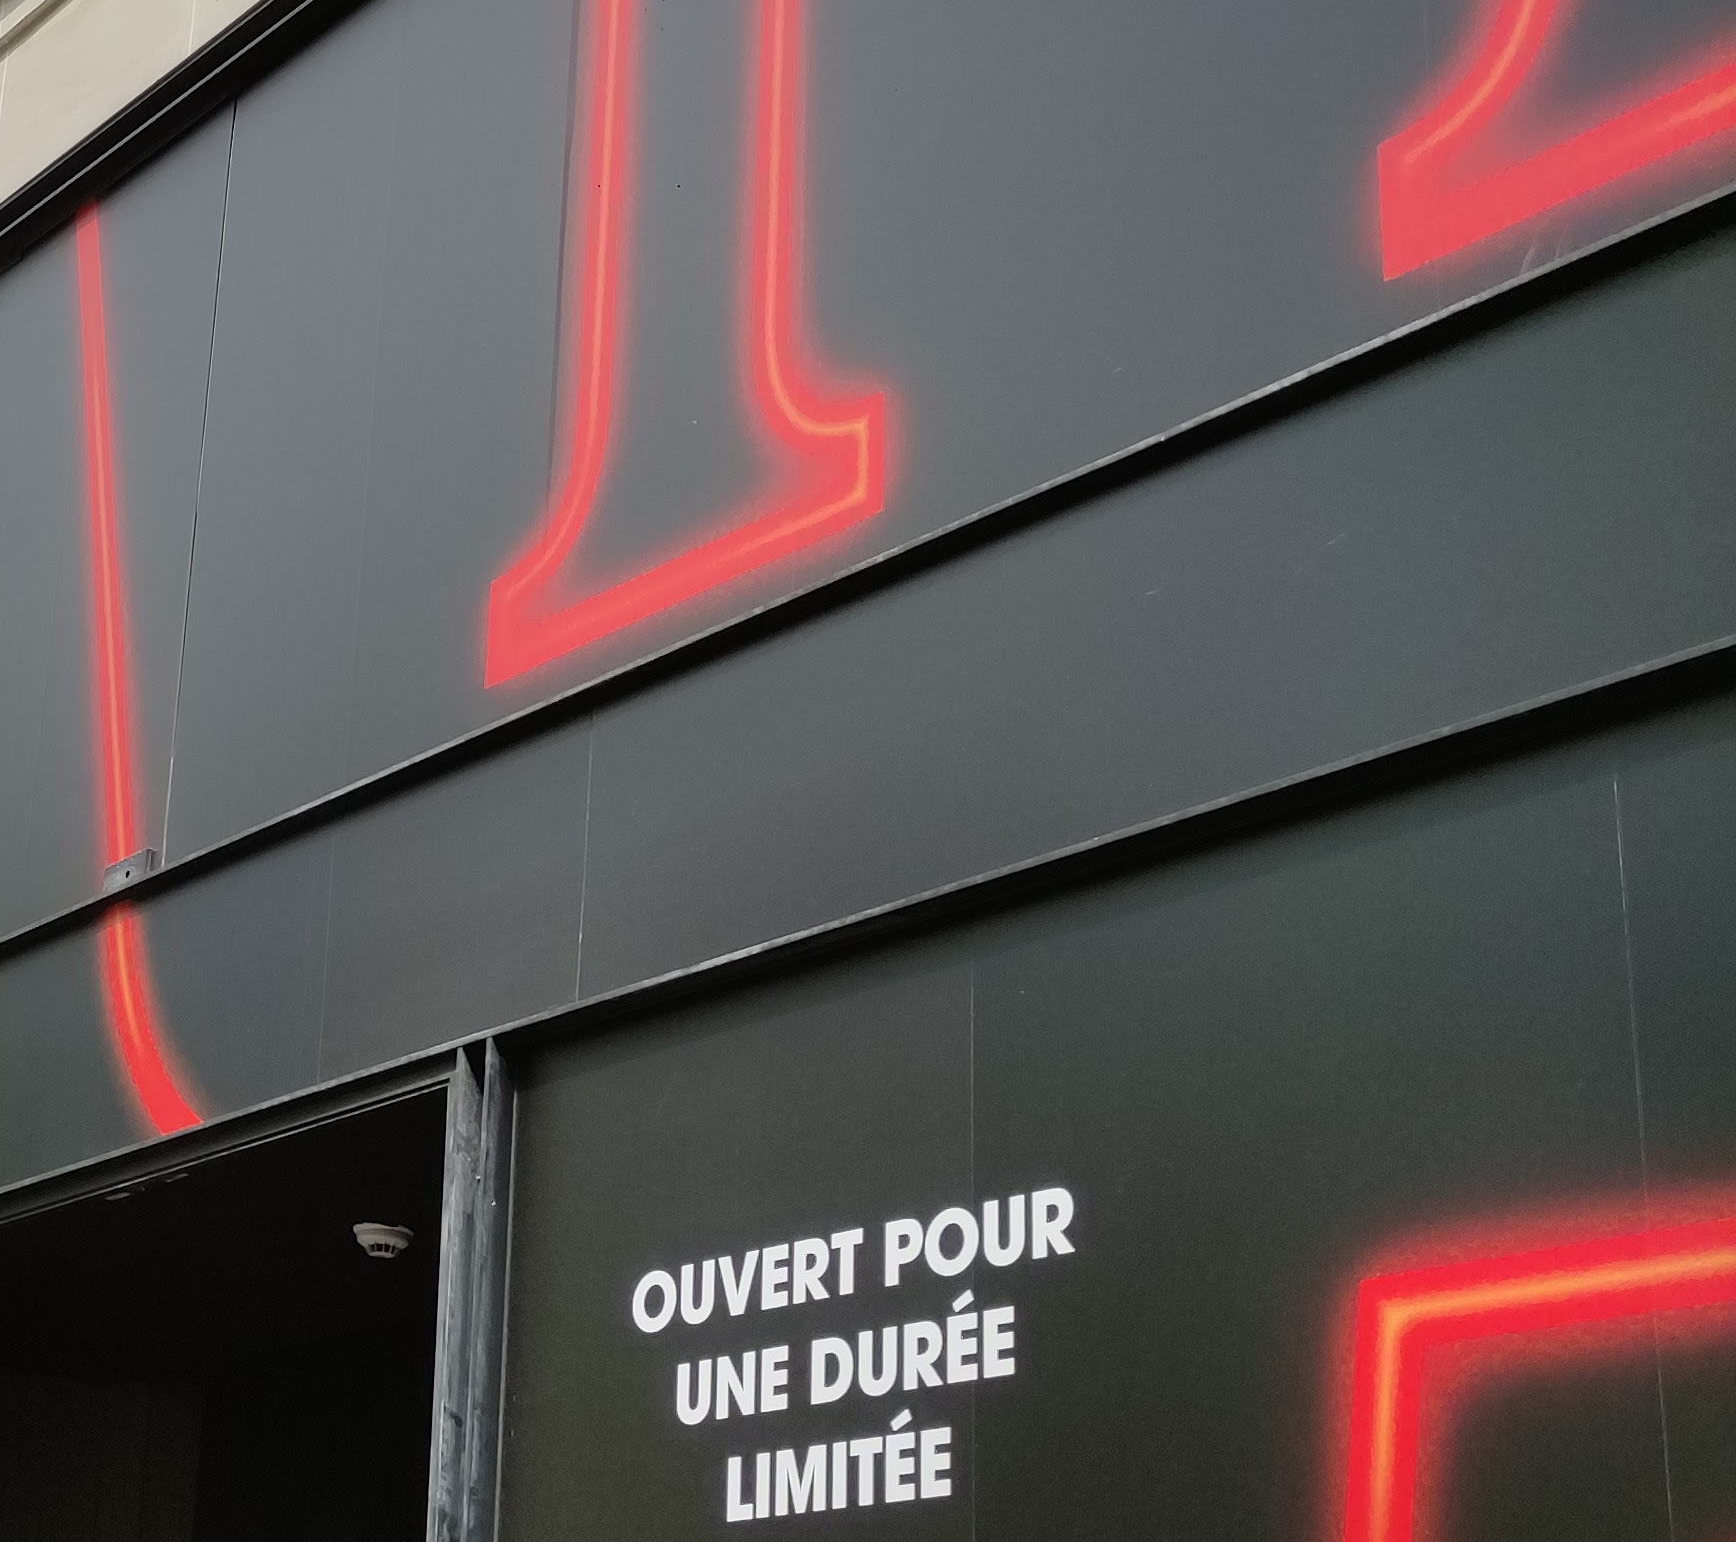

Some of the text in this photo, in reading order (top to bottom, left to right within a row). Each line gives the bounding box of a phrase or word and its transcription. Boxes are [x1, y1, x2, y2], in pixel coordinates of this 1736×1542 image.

[631, 1186, 1076, 1334] OUVERT POUR
[675, 1288, 1016, 1426] UNE DURÉE
[725, 1408, 952, 1523] LIMITÉE
